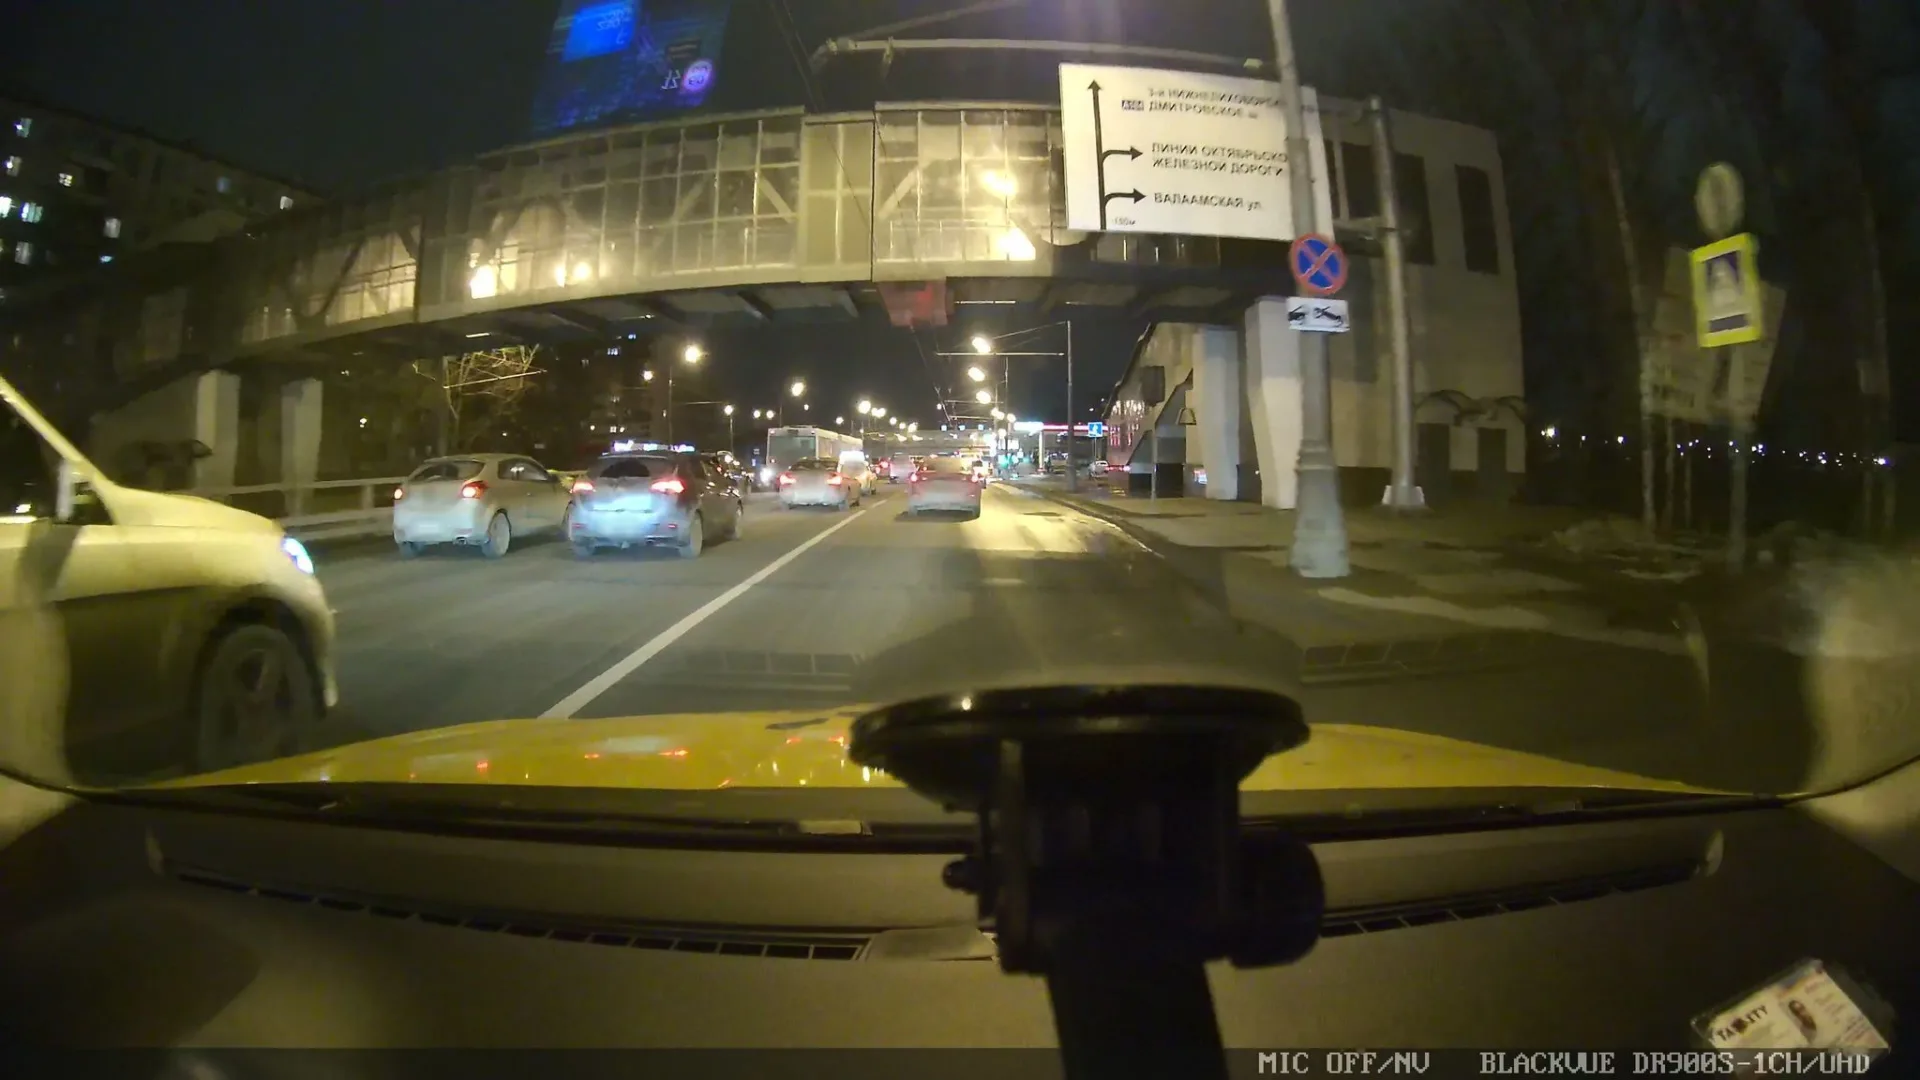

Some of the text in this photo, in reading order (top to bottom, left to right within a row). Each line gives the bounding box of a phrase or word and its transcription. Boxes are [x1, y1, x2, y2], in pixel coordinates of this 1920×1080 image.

[1149, 100, 1243, 118] ДМИТРОВСКОЕ
[1152, 142, 1289, 162] ЛИНИИ ОКТЯБРЬСКО
[1153, 157, 1283, 176] ЖЕЛЕЗНОЙ ДОРОГИ
[1154, 192, 1244, 208] ВАЛААМСКАЯ
